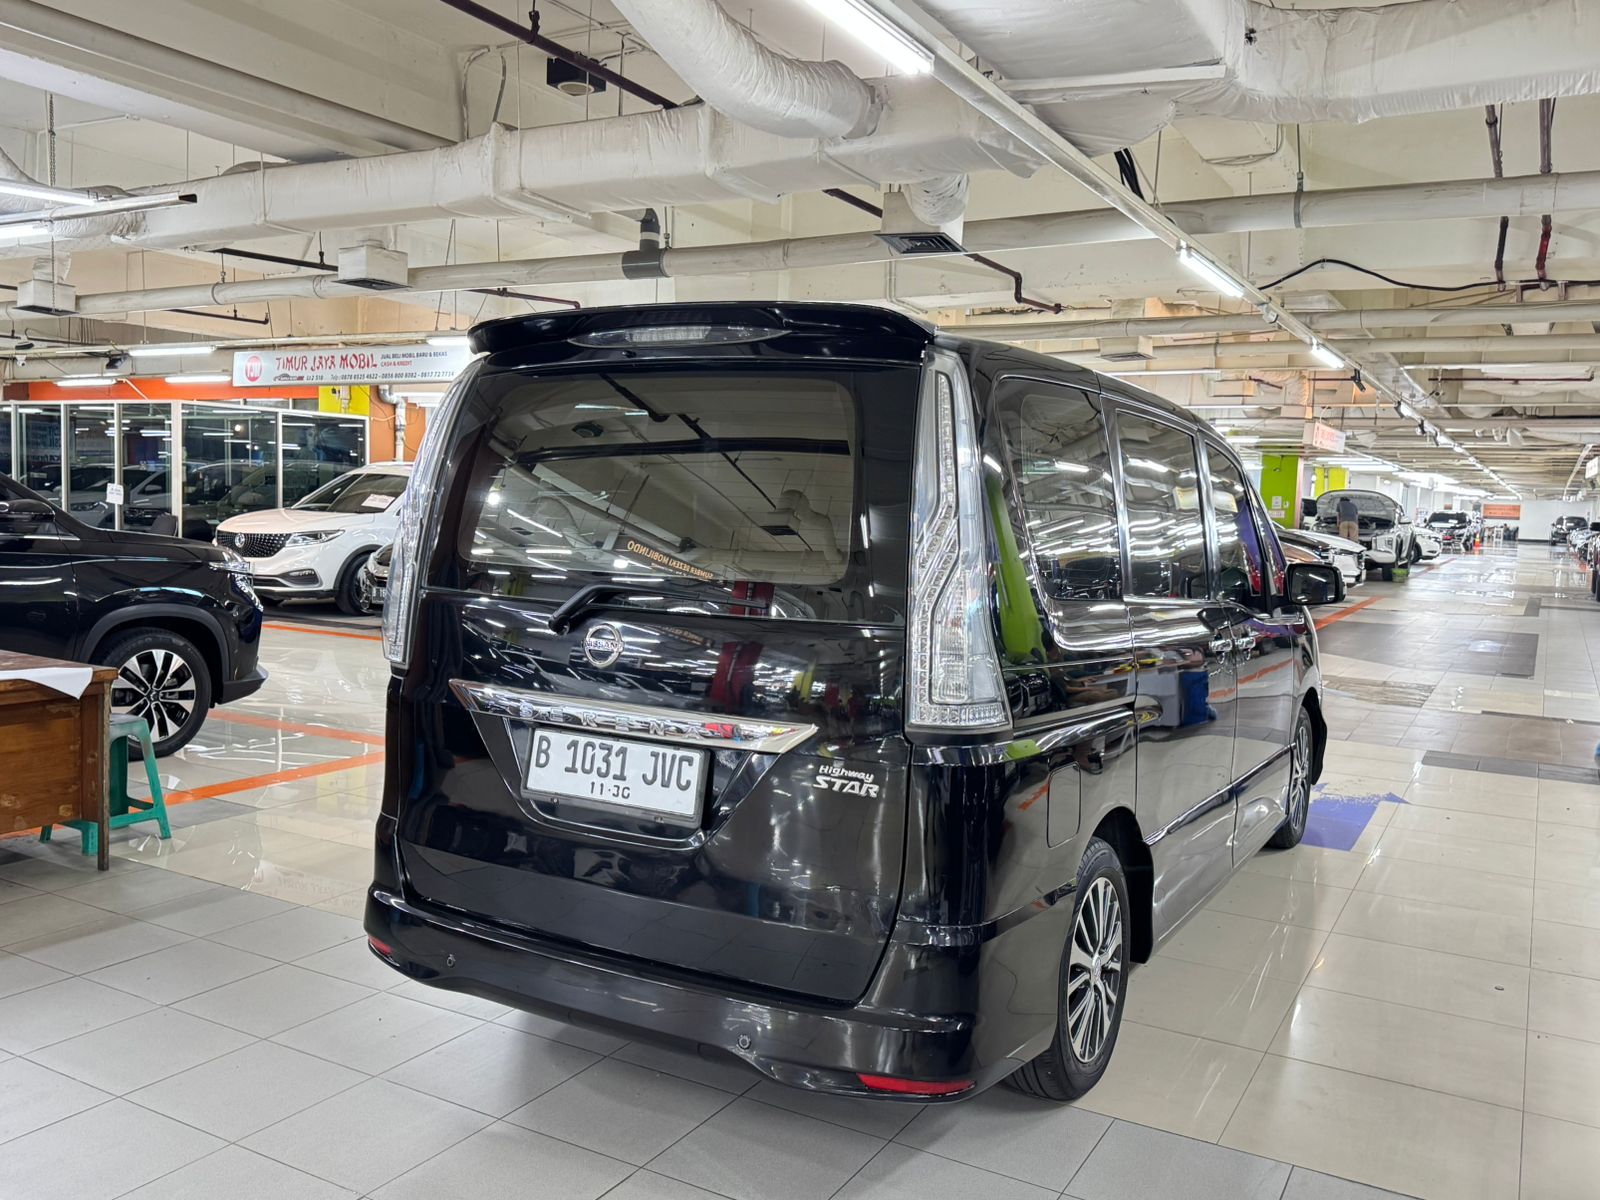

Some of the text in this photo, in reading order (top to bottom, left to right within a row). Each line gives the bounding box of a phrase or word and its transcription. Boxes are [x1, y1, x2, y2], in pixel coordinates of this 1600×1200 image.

[276, 352, 378, 372] TIMUR JAYA MOBIL
[585, 639, 619, 650] NISSAN
[519, 701, 703, 740] SERENA
[535, 734, 694, 791] B 1031 JVC
[819, 764, 875, 784] Highway
[813, 775, 880, 798] STAR
